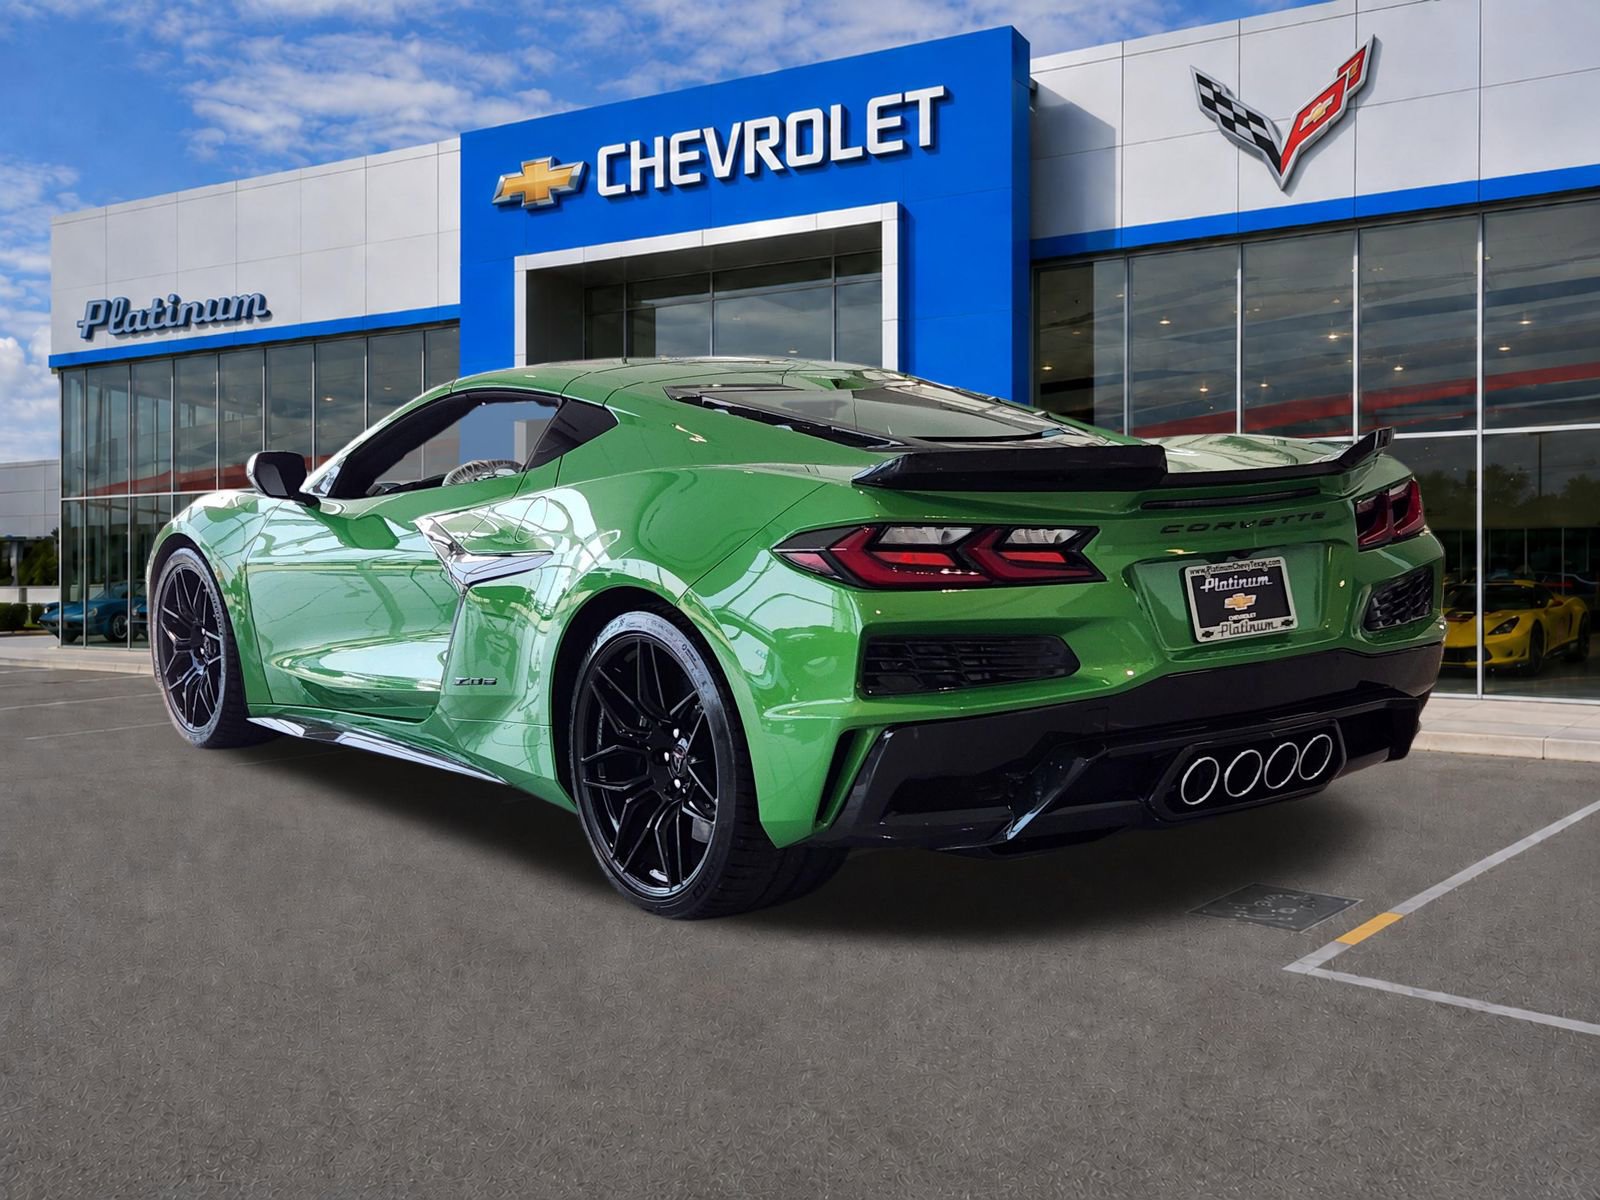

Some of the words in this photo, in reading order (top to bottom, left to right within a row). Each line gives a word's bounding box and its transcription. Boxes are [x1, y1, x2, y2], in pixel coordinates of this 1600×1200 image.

[597, 85, 946, 197] CHEVROLET
[76, 293, 272, 341] Platinum
[1160, 511, 1327, 534] CORVETTE
[1200, 575, 1273, 592] Platinum
[1218, 620, 1278, 637] Platinum
[453, 677, 498, 686] Z06
